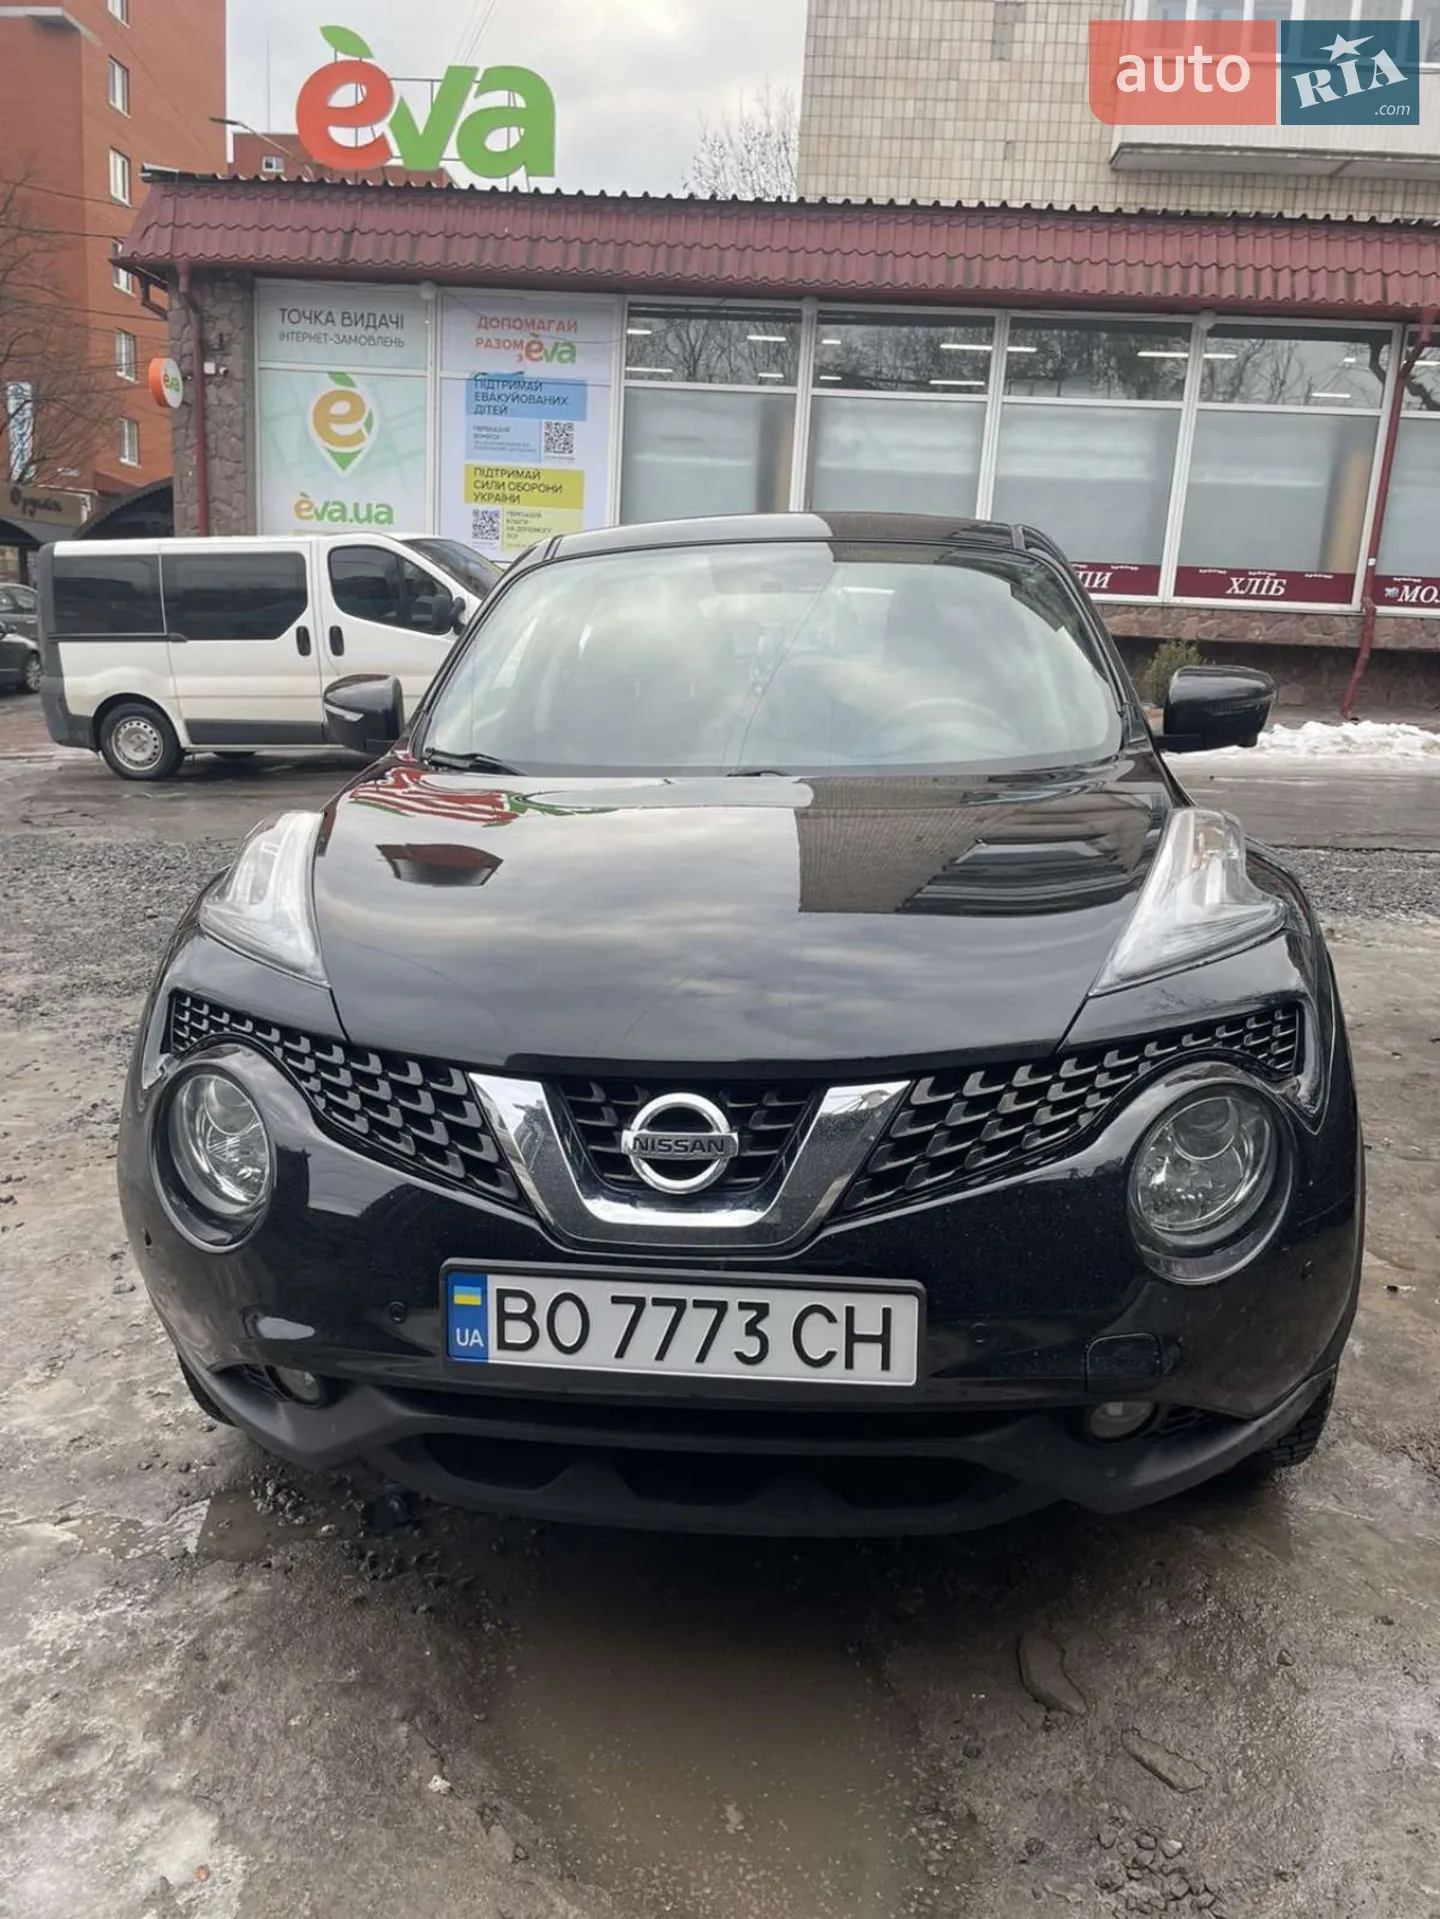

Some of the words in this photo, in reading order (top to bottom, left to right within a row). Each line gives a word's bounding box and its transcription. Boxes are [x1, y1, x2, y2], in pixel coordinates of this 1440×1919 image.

[279, 307, 336, 326] ТОЧКА
[341, 311, 404, 331] ВИДАЧІ
[477, 316, 578, 333] ДОПОМАГАЙ
[279, 331, 405, 348] ІНТЕРНЕТ-ЗАМОВЛЕНЬ
[475, 337, 524, 351] РАЗОМ
[474, 378, 543, 392] ПІДТРИМАЙ
[474, 391, 569, 406] ЕВАКУЙОВАНИХ
[474, 404, 508, 415] ДІТЕЙ
[474, 467, 541, 480] ПІДТРИМАЙ
[473, 479, 506, 488] СИЛИ
[508, 481, 563, 494] ОБОРОНИ
[473, 492, 520, 504] УКРАЇНИ
[1225, 576, 1287, 596] ХЛІБ
[1397, 584, 1440, 603] МО
[632, 1136, 725, 1156] NISSAN
[455, 1327, 484, 1347] UA
[496, 1288, 590, 1355] BO
[611, 1295, 770, 1366] 7773
[792, 1303, 892, 1371] CH
